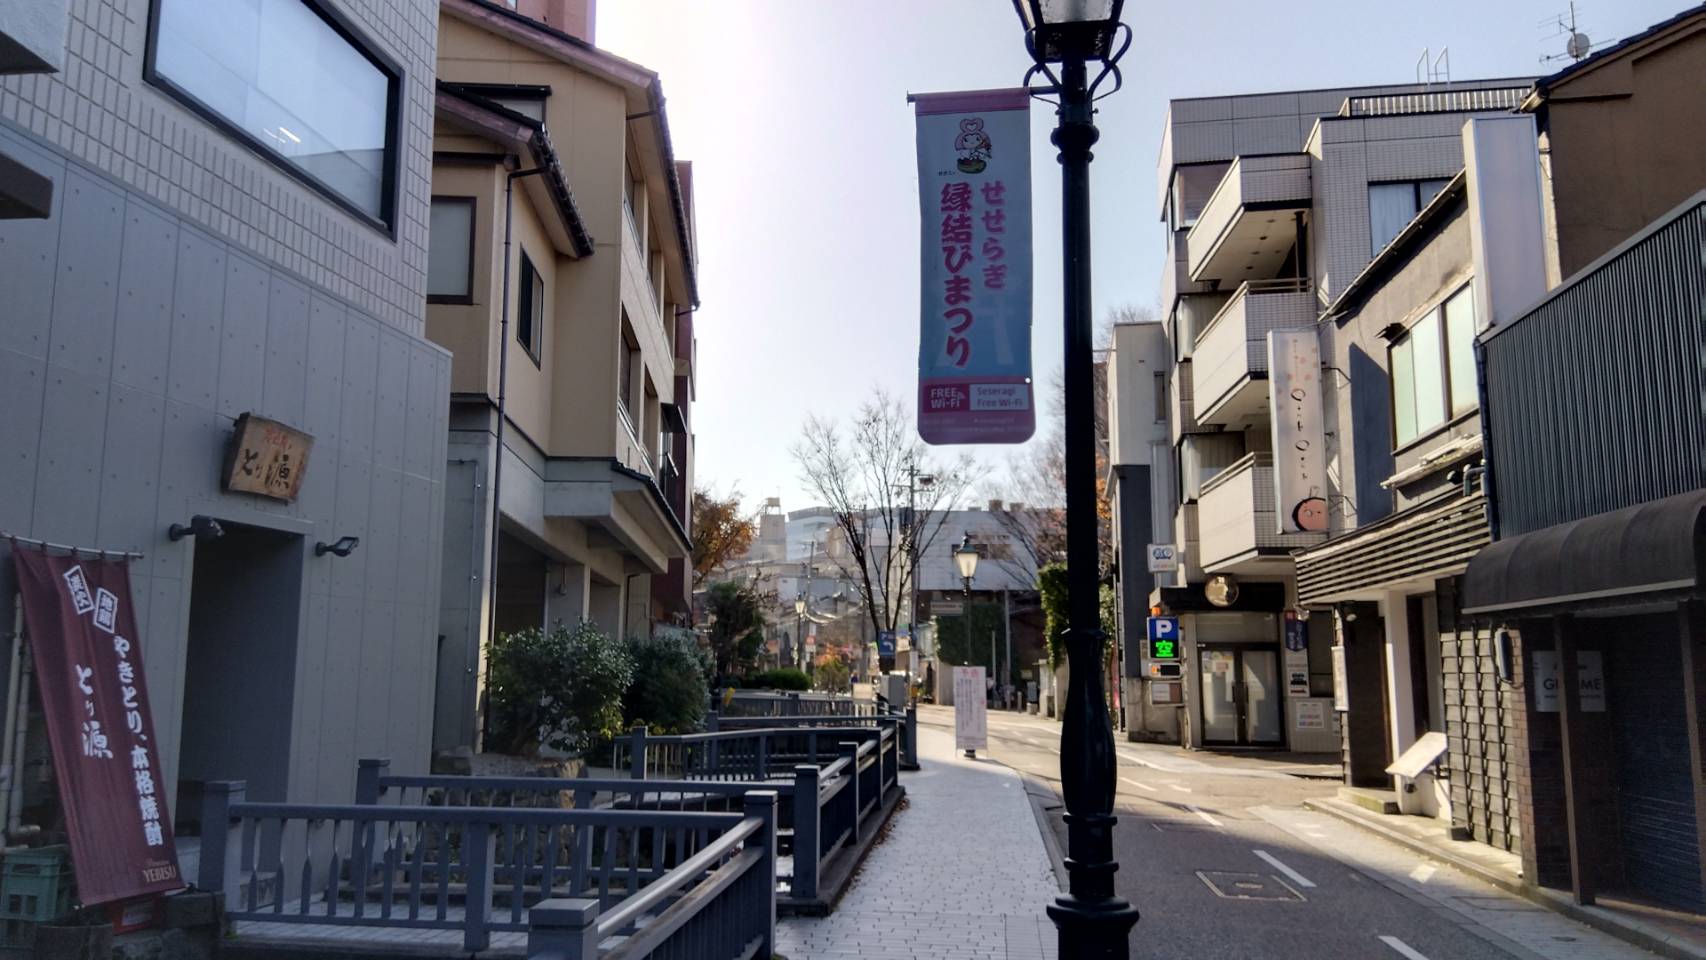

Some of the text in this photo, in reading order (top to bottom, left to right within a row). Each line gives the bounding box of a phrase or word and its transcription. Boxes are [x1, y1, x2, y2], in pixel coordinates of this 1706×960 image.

[981, 180, 1007, 290] せせらぎ
[940, 182, 974, 367] 縁結びまつり
[930, 387, 957, 398] FREE
[976, 387, 1016, 397] Seseragi
[977, 399, 1024, 407] Free Wi-Fi
[1156, 620, 1173, 638] P
[1155, 640, 1174, 657] 空
[75, 664, 113, 759] とり源
[142, 865, 177, 883] YEBISU
